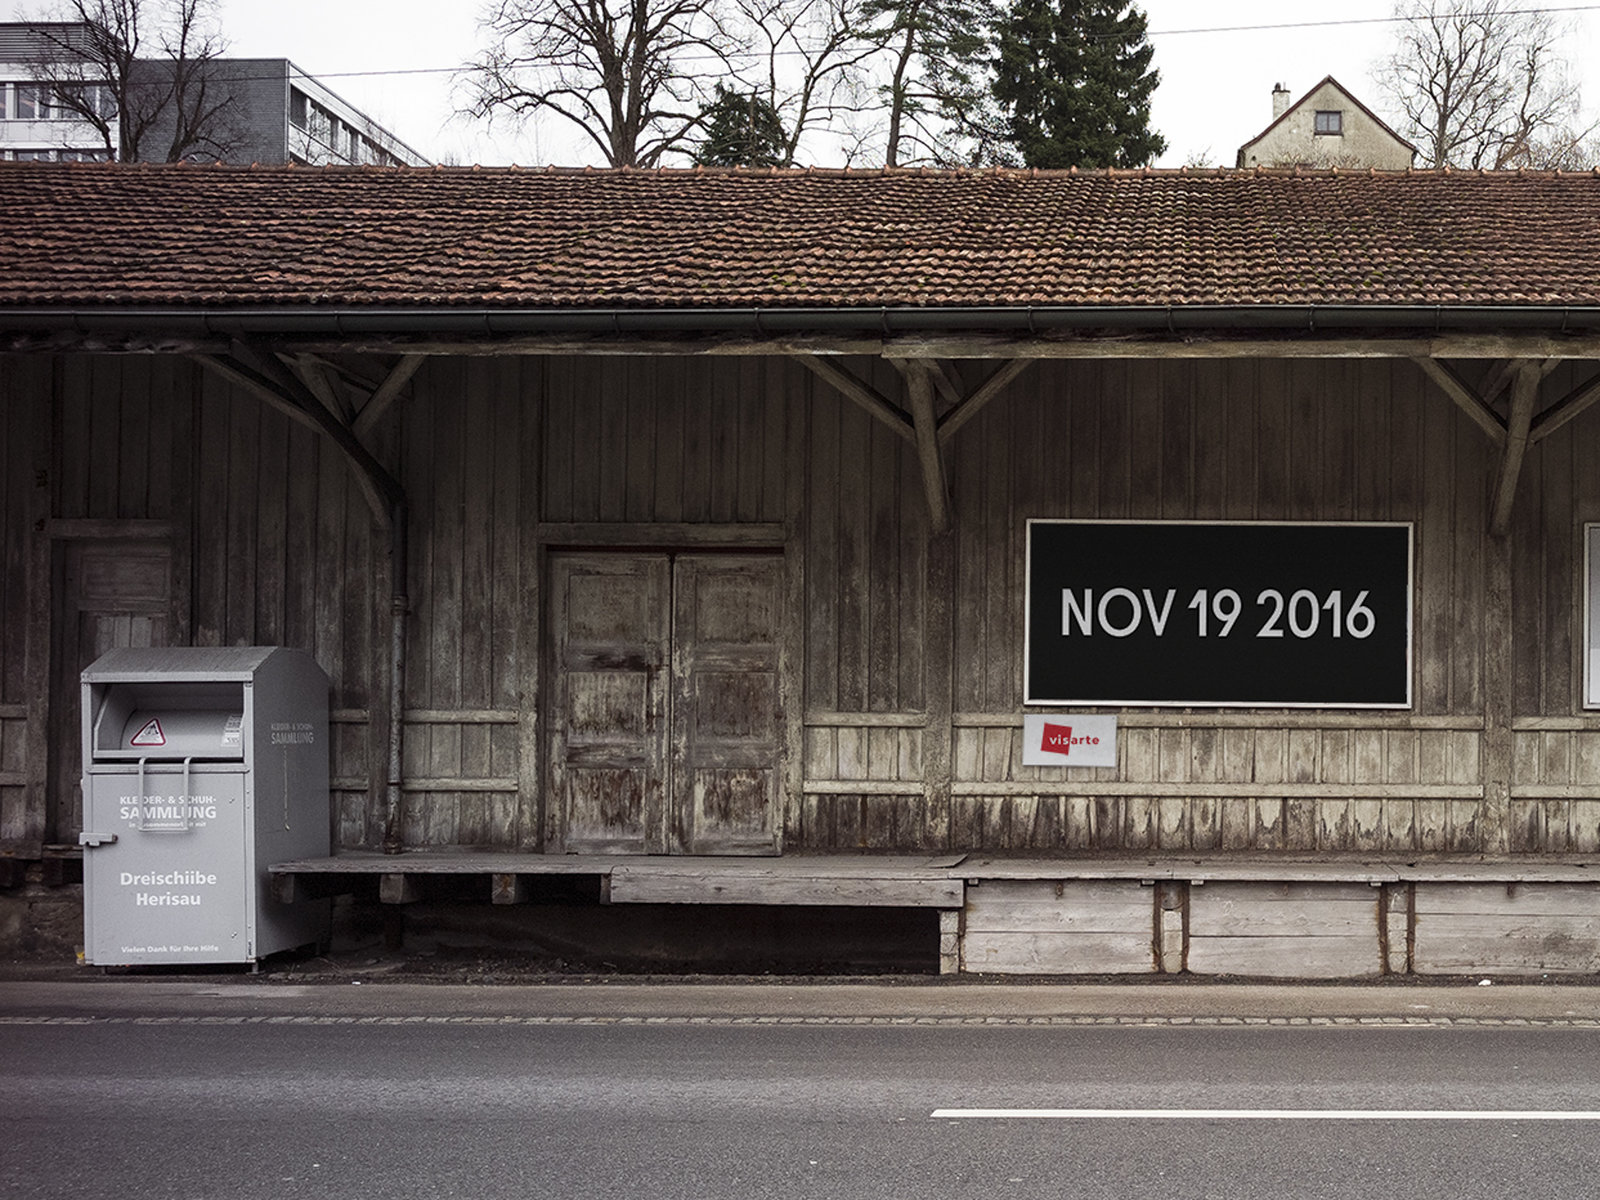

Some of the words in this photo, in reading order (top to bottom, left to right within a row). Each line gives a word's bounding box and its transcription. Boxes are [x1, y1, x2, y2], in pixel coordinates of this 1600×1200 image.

[1061, 588, 1177, 637] NOV
[1188, 589, 1242, 637] 19
[1256, 589, 1376, 639] 2016
[1049, 734, 1100, 745] visarte
[120, 796, 165, 804] KLEDER-
[168, 796, 175, 804] &
[120, 871, 217, 886] Dreischiibe
[136, 892, 201, 906] Herisau
